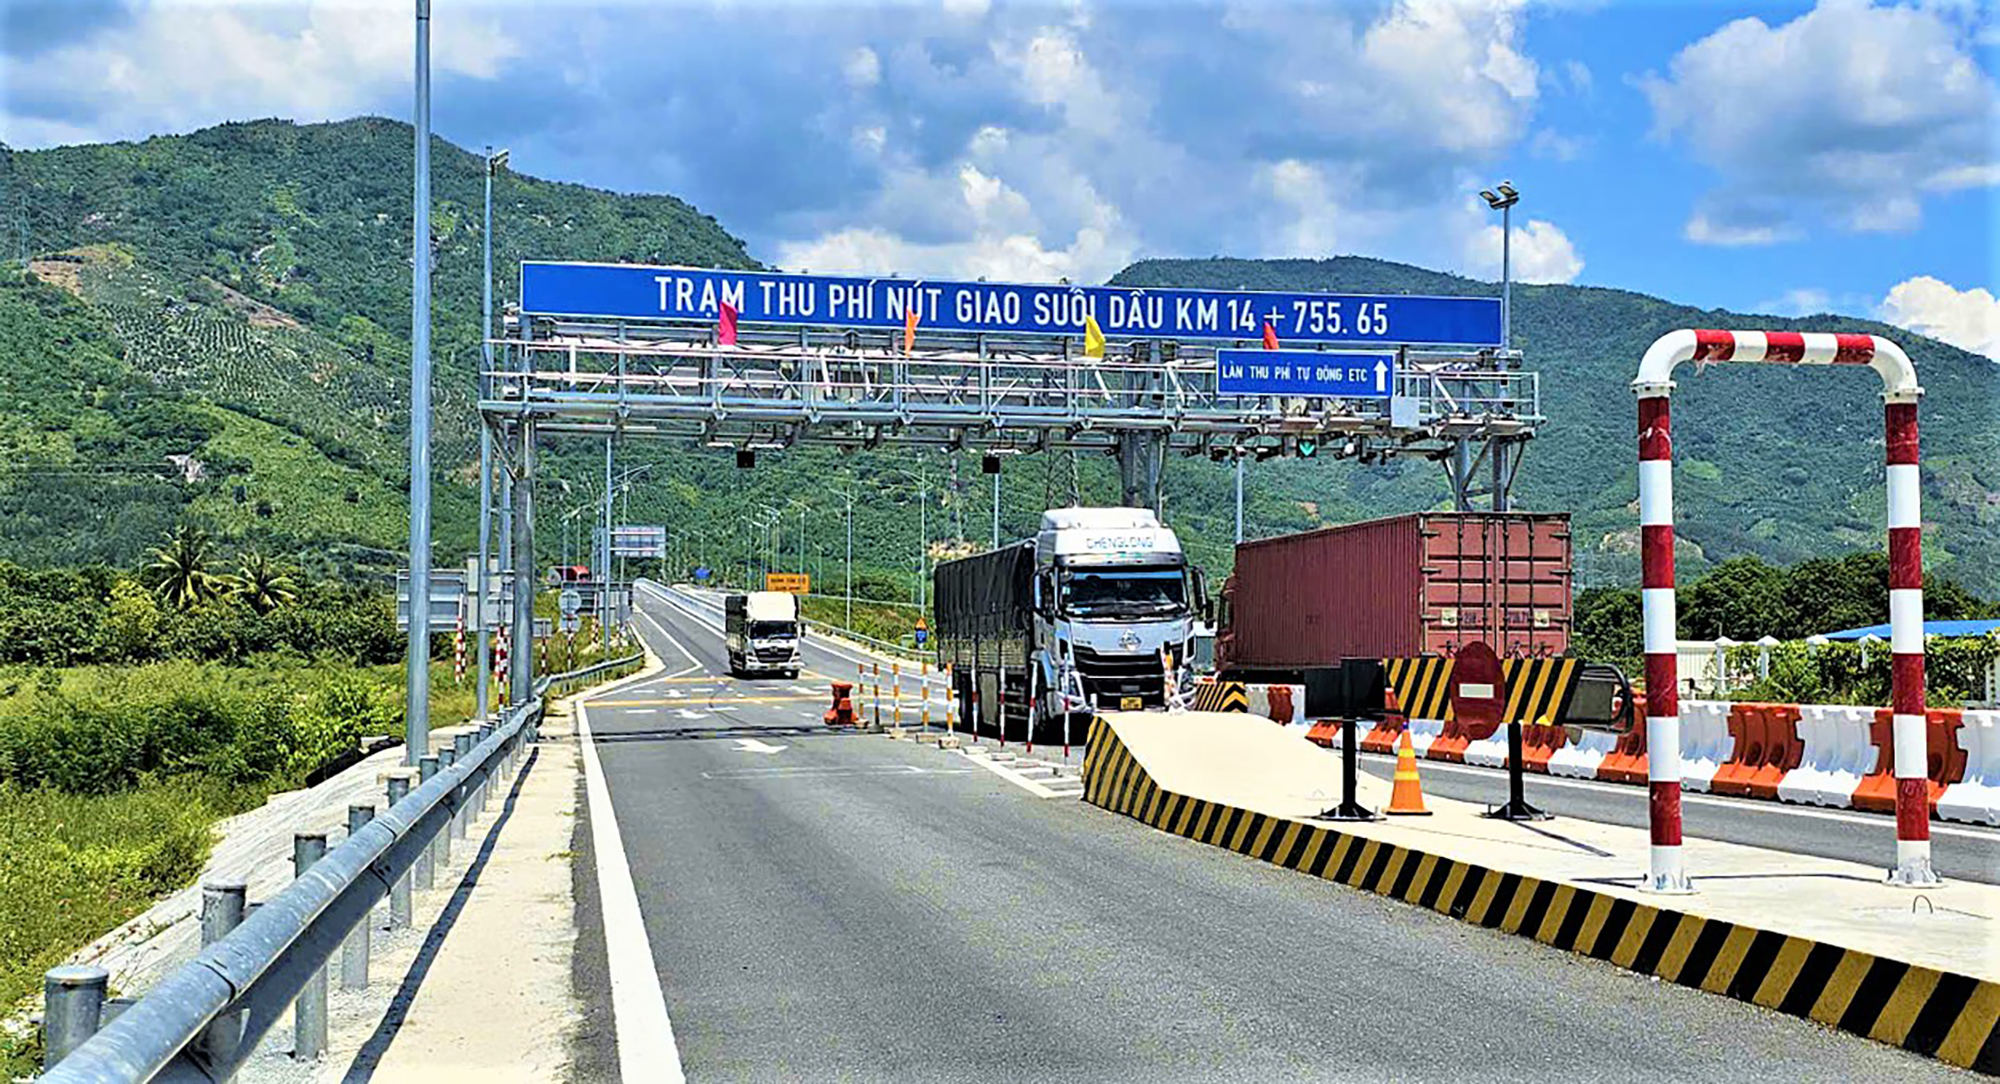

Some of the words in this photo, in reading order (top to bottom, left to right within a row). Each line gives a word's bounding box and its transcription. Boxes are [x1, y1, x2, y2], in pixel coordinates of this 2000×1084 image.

[654, 276, 744, 317] TRẠM
[759, 281, 815, 316] THU
[829, 279, 877, 319] PHÍ
[887, 280, 942, 322] NÚT
[956, 289, 1020, 325] GIAO
[1034, 287, 1096, 327] SUỐI
[1109, 288, 1163, 329] DẦU
[1176, 297, 1218, 331] KM
[1227, 299, 1256, 331] 14
[1263, 306, 1285, 327] +
[1357, 303, 1388, 335] 65
[1222, 360, 1243, 379] LÀN
[1250, 365, 1269, 379] THU
[1274, 361, 1291, 380] PHÍ
[1316, 364, 1342, 384] ĐỘNG
[1348, 367, 1368, 382] ETC
